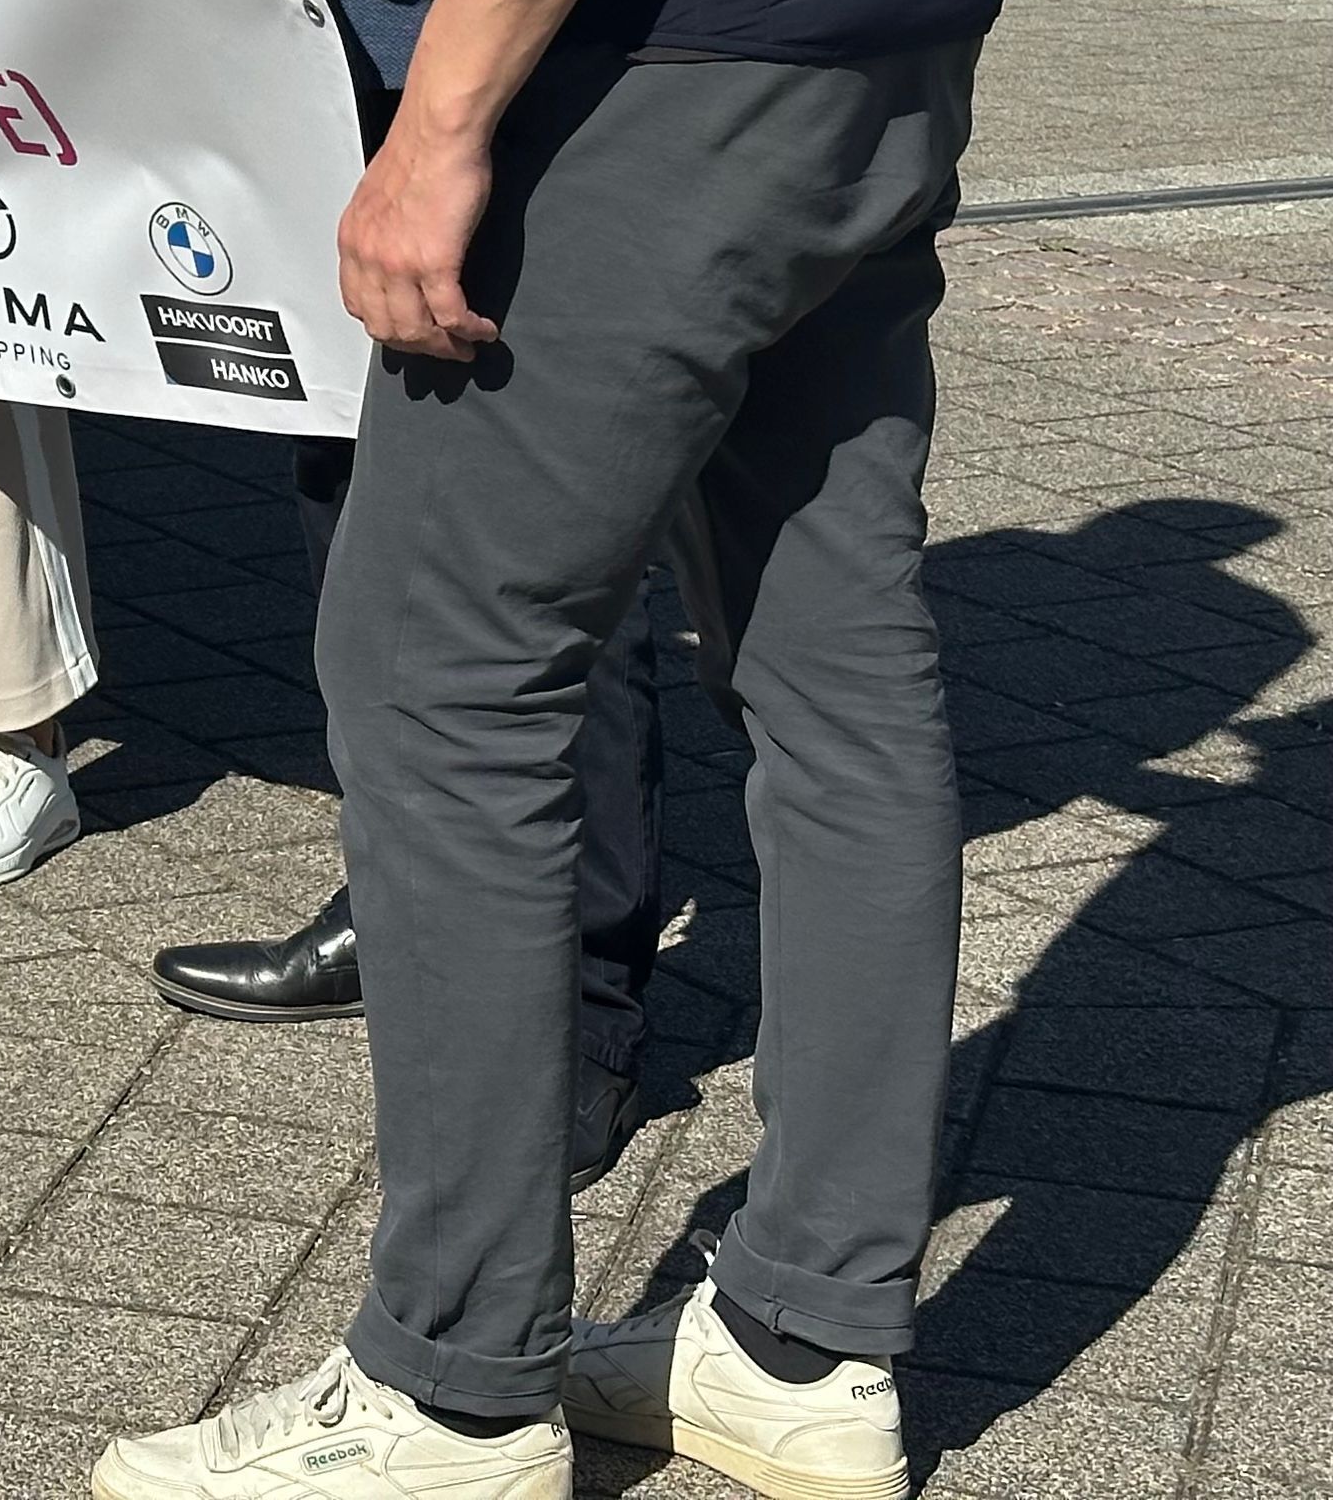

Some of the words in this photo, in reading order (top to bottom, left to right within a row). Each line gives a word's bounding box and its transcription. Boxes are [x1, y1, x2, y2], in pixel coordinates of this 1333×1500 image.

[157, 206, 210, 238] BMW
[157, 306, 275, 342] HAKVOORT
[211, 359, 290, 389] HANKO
[851, 1376, 893, 1400] Reeb
[306, 1443, 368, 1469] Reebok
